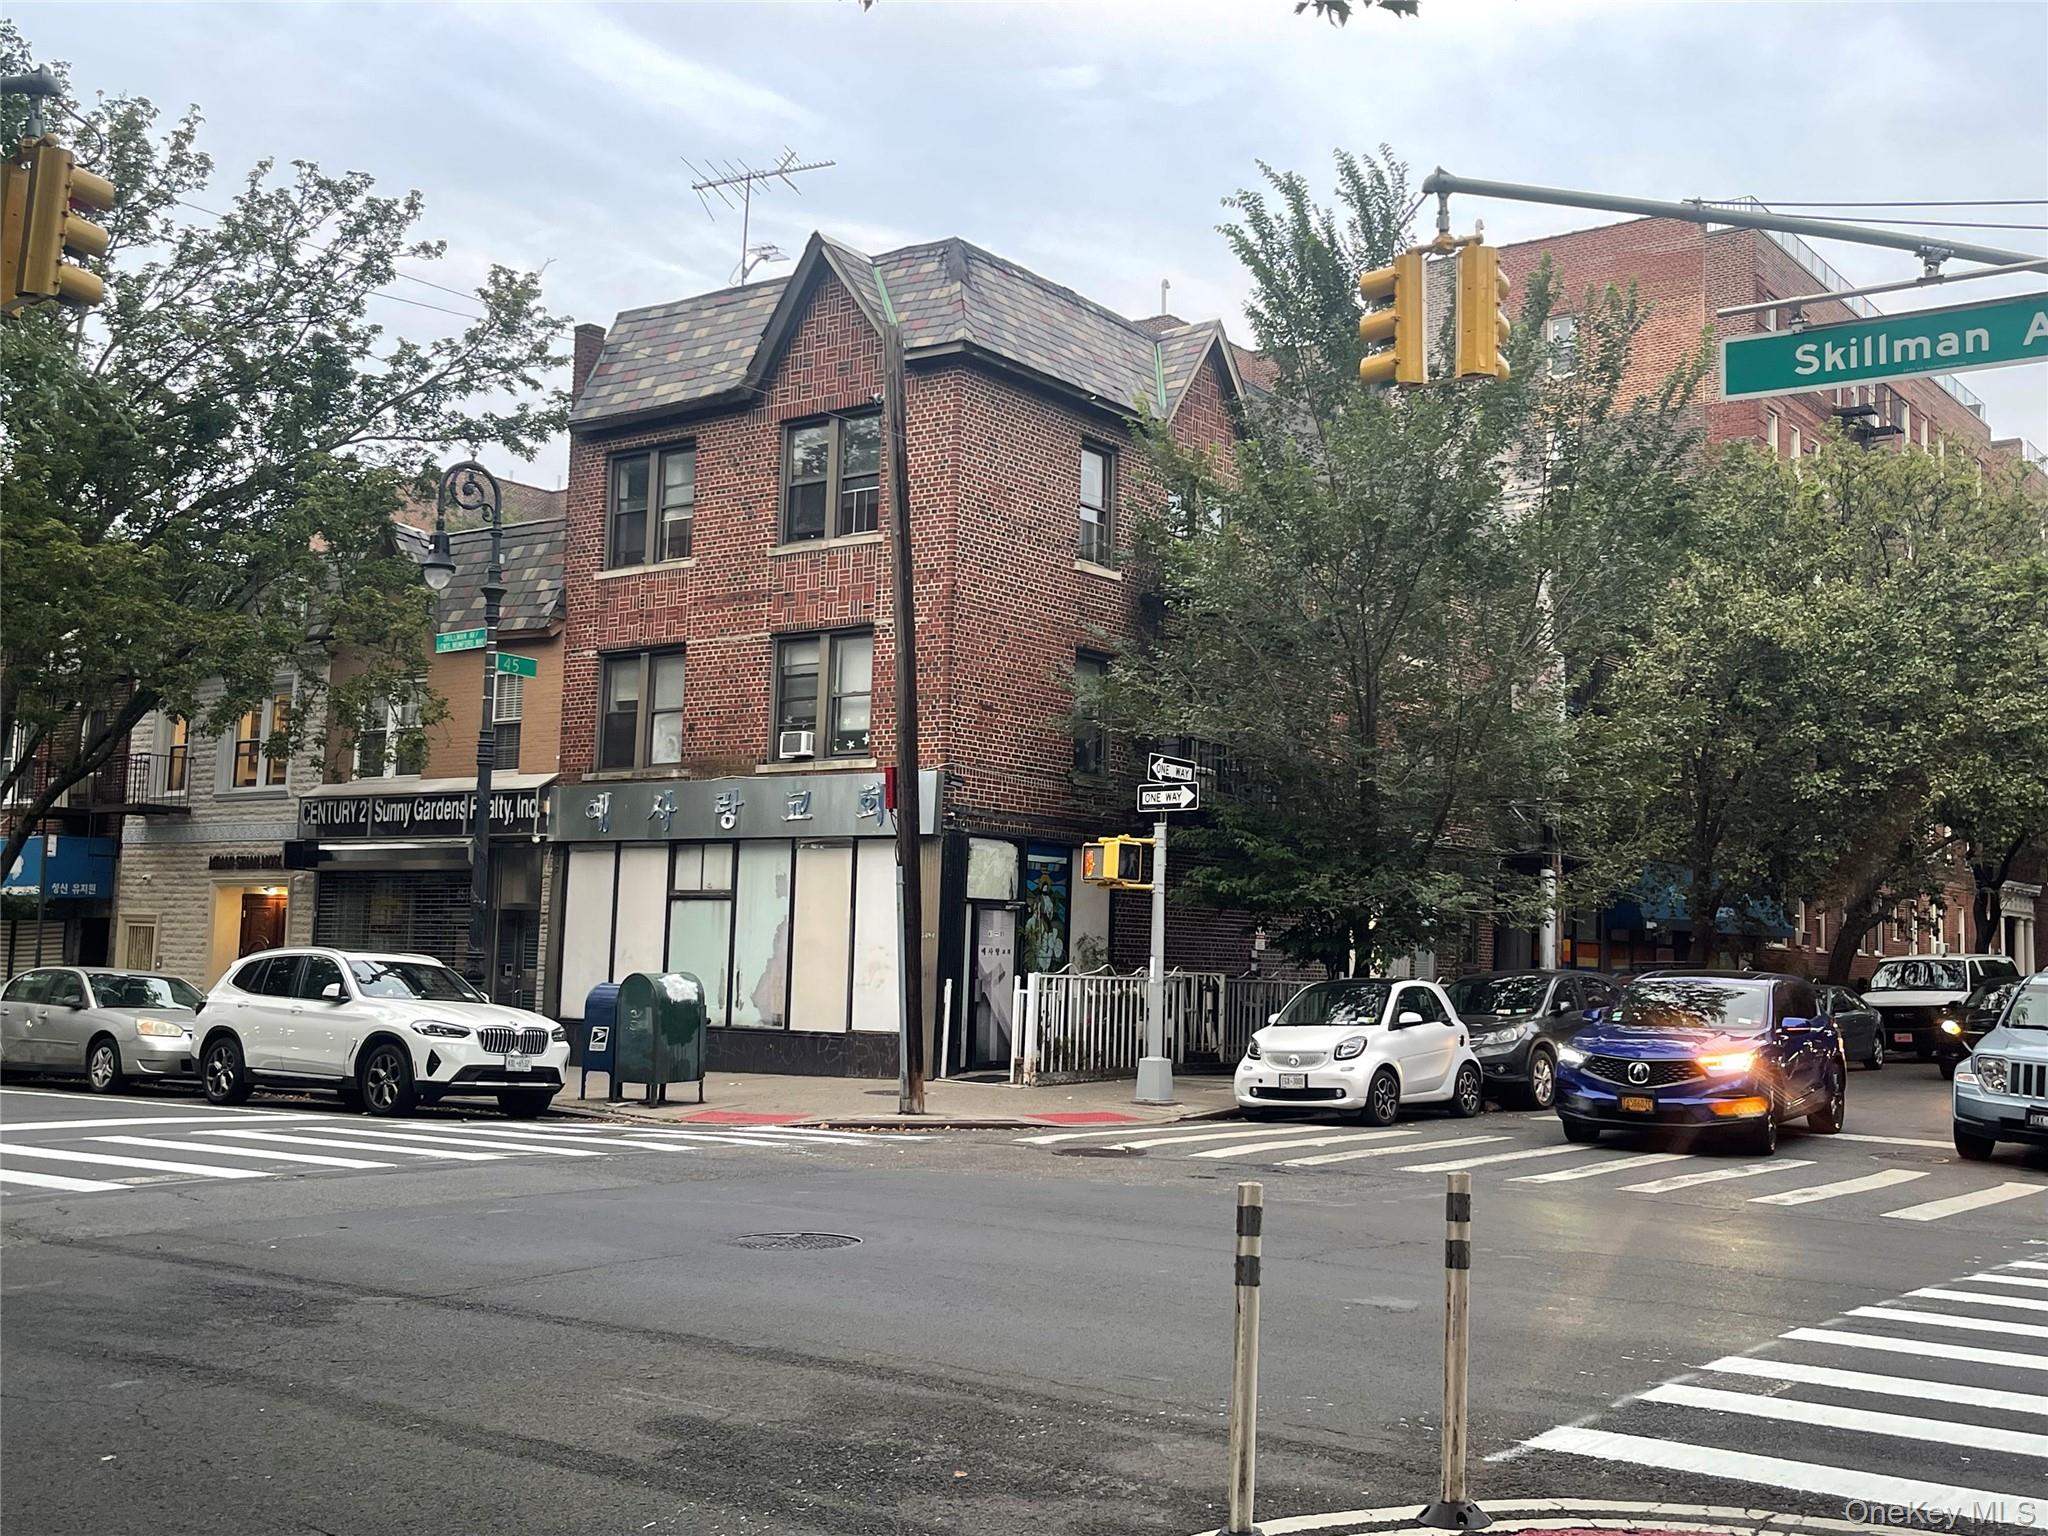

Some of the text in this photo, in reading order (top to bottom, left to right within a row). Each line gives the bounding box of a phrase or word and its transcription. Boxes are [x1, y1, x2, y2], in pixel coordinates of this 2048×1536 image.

[1793, 326, 1990, 376] Skillman
[503, 657, 520, 672] 45
[1156, 763, 1190, 779] ONE WAY
[1145, 791, 1182, 804] ONE WAY
[303, 800, 357, 825] CENTURY
[374, 799, 412, 828] Sunny
[413, 797, 466, 821] Gardens
